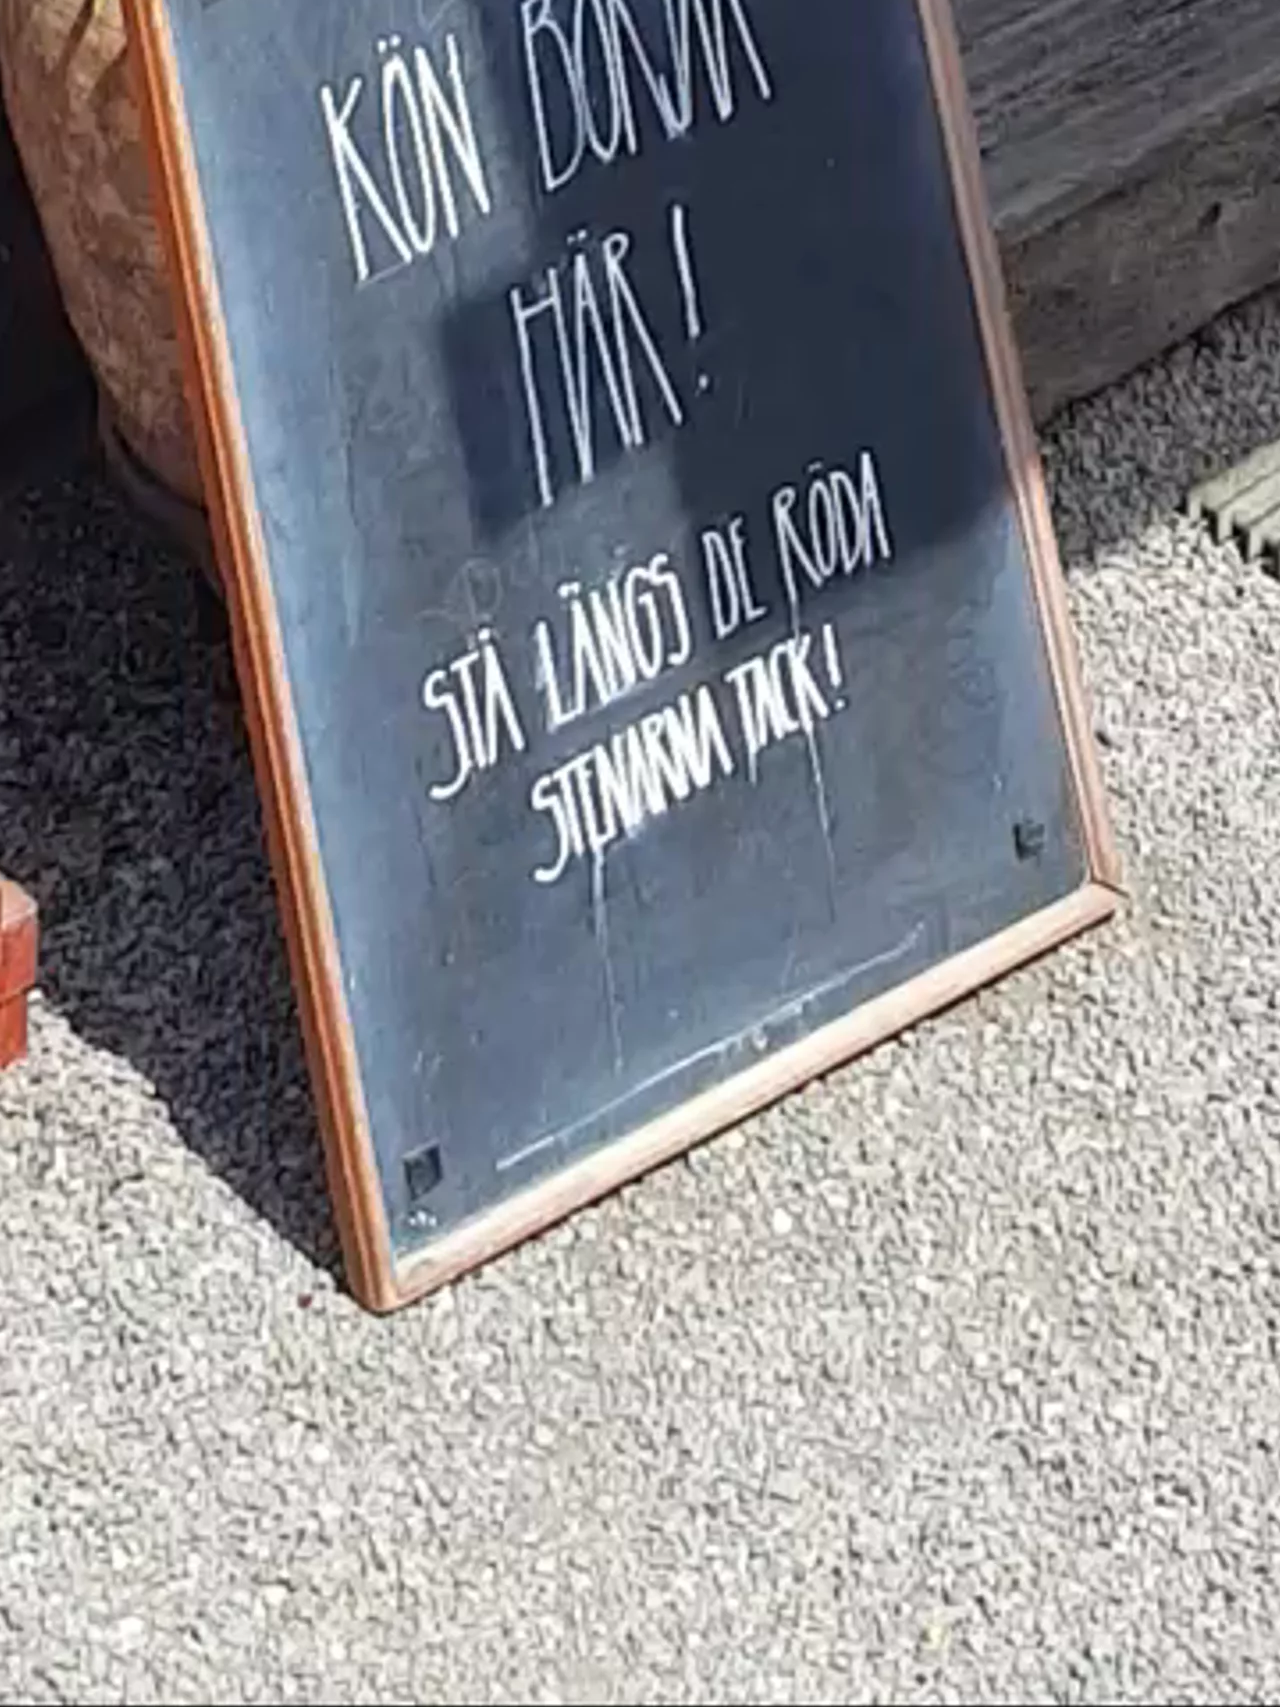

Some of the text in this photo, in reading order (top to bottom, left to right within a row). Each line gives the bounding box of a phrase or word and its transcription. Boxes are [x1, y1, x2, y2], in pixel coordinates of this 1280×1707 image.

[320, 31, 493, 282] KÖN
[534, 550, 693, 734] LÄNGS
[701, 514, 769, 641] DE
[772, 448, 893, 610] RÖDA
[531, 620, 847, 884] STENARNA TACK!
